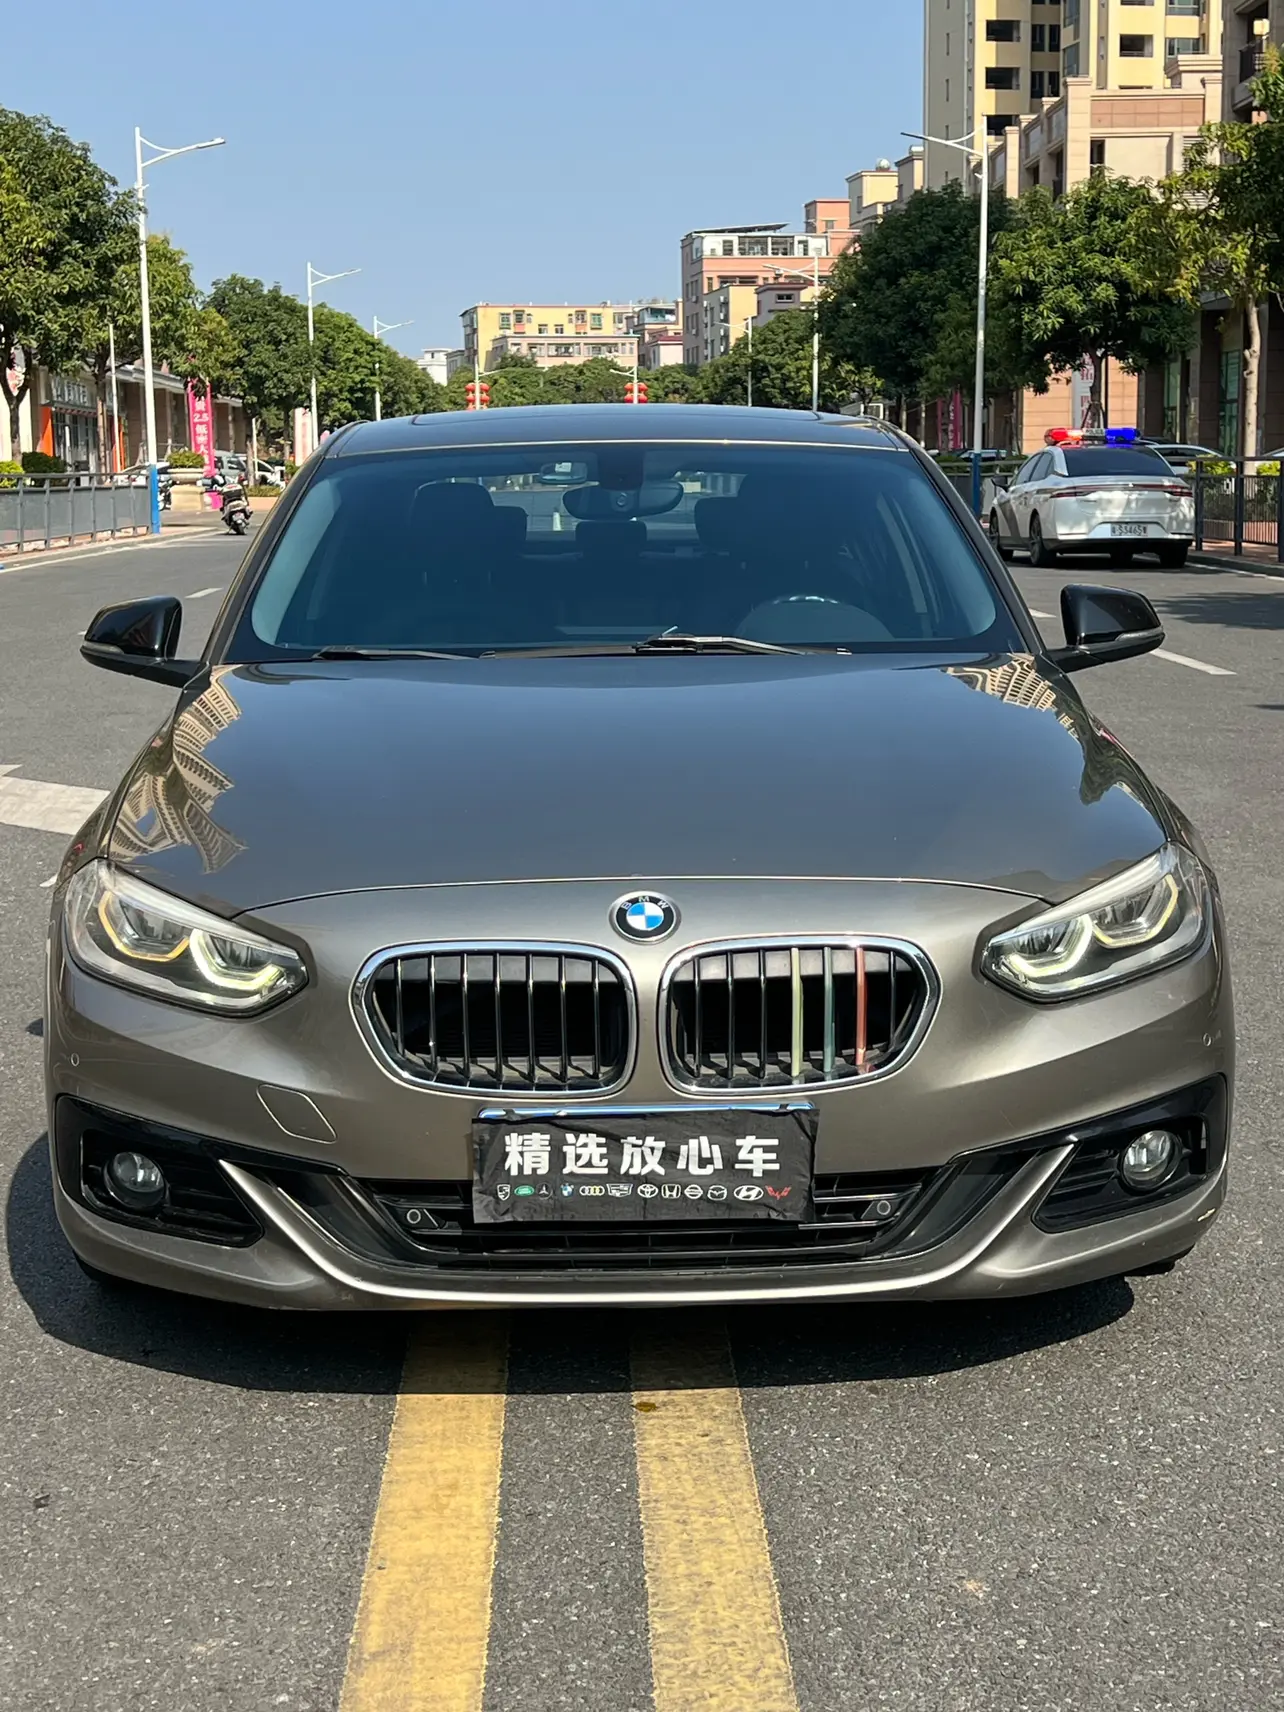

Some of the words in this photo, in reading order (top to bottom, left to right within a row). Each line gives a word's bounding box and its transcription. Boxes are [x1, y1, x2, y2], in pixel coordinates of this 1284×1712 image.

[621, 895, 669, 909] BMW
[504, 1132, 780, 1177] 精选放心车
